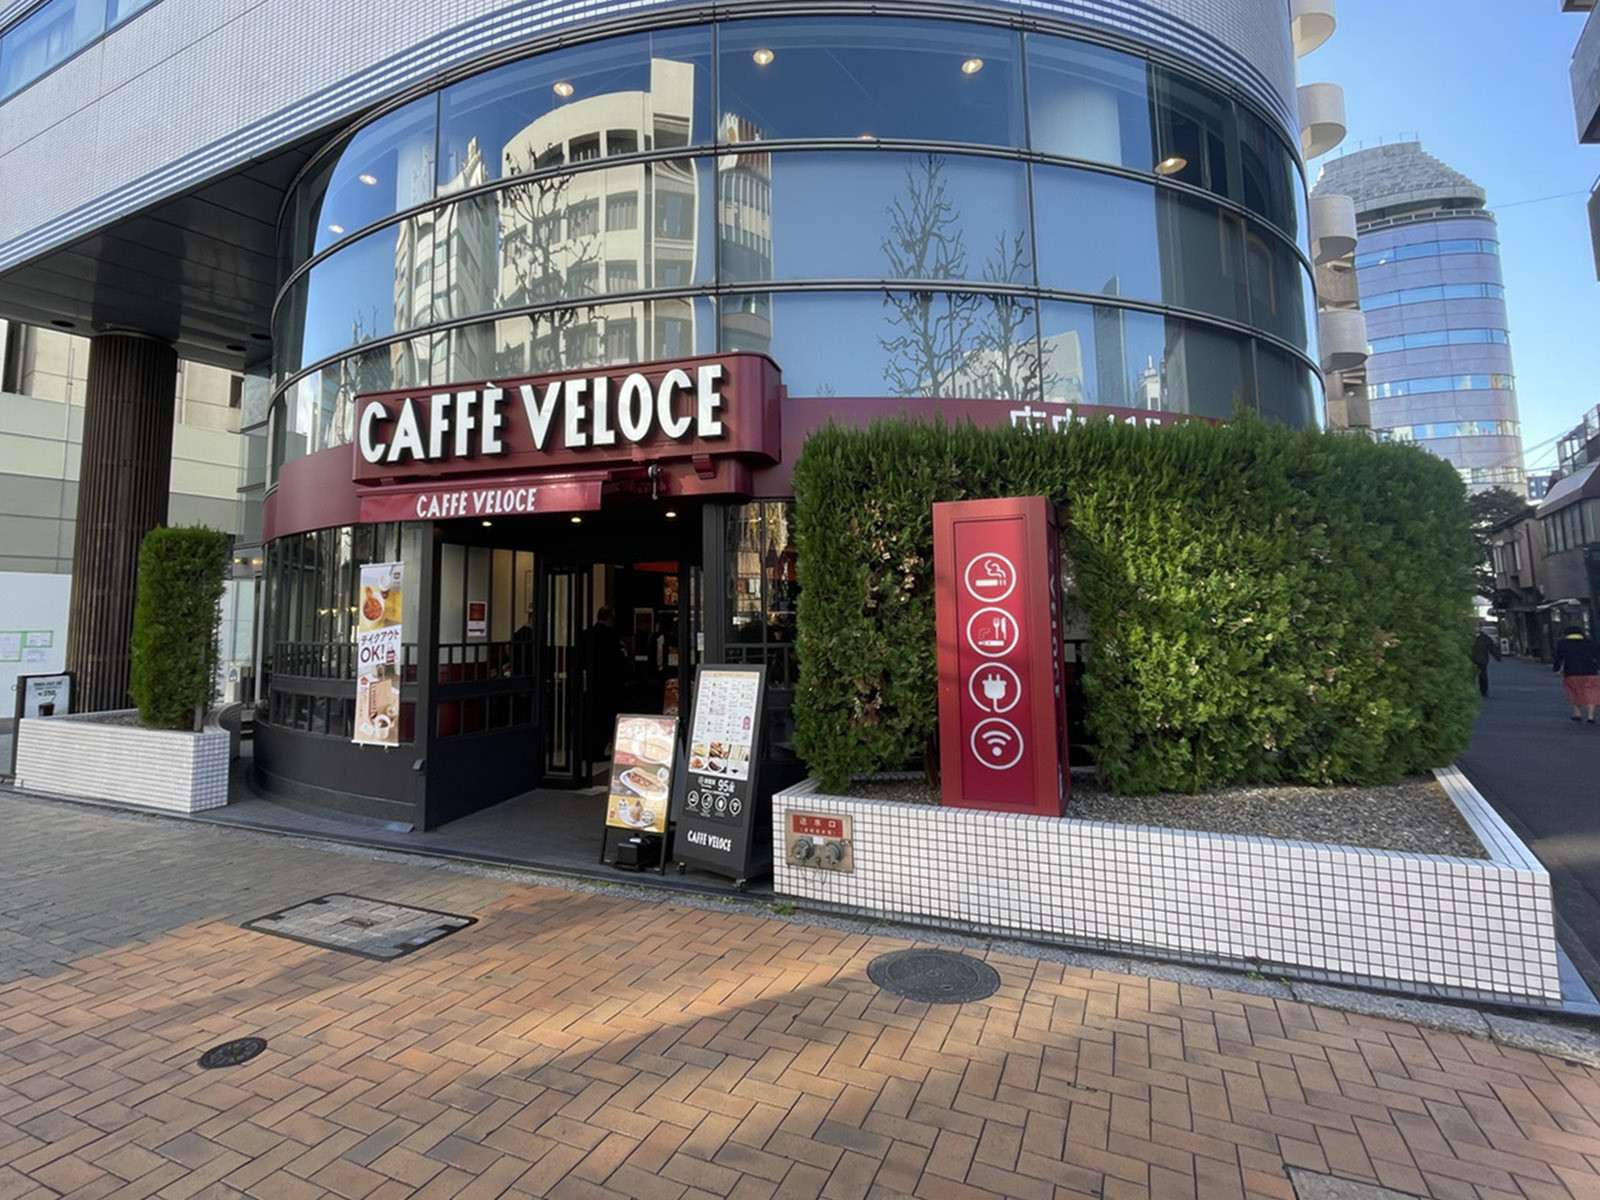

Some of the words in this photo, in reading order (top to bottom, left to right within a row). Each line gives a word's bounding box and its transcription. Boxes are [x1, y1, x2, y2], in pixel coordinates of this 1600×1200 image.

[359, 381, 504, 463] CAFFÈ
[519, 364, 722, 450] VELOCE
[472, 487, 537, 513] VELOCE
[361, 629, 400, 646] テイクアウト
[360, 644, 385, 663] OK!
[708, 834, 732, 852] VELOCE
